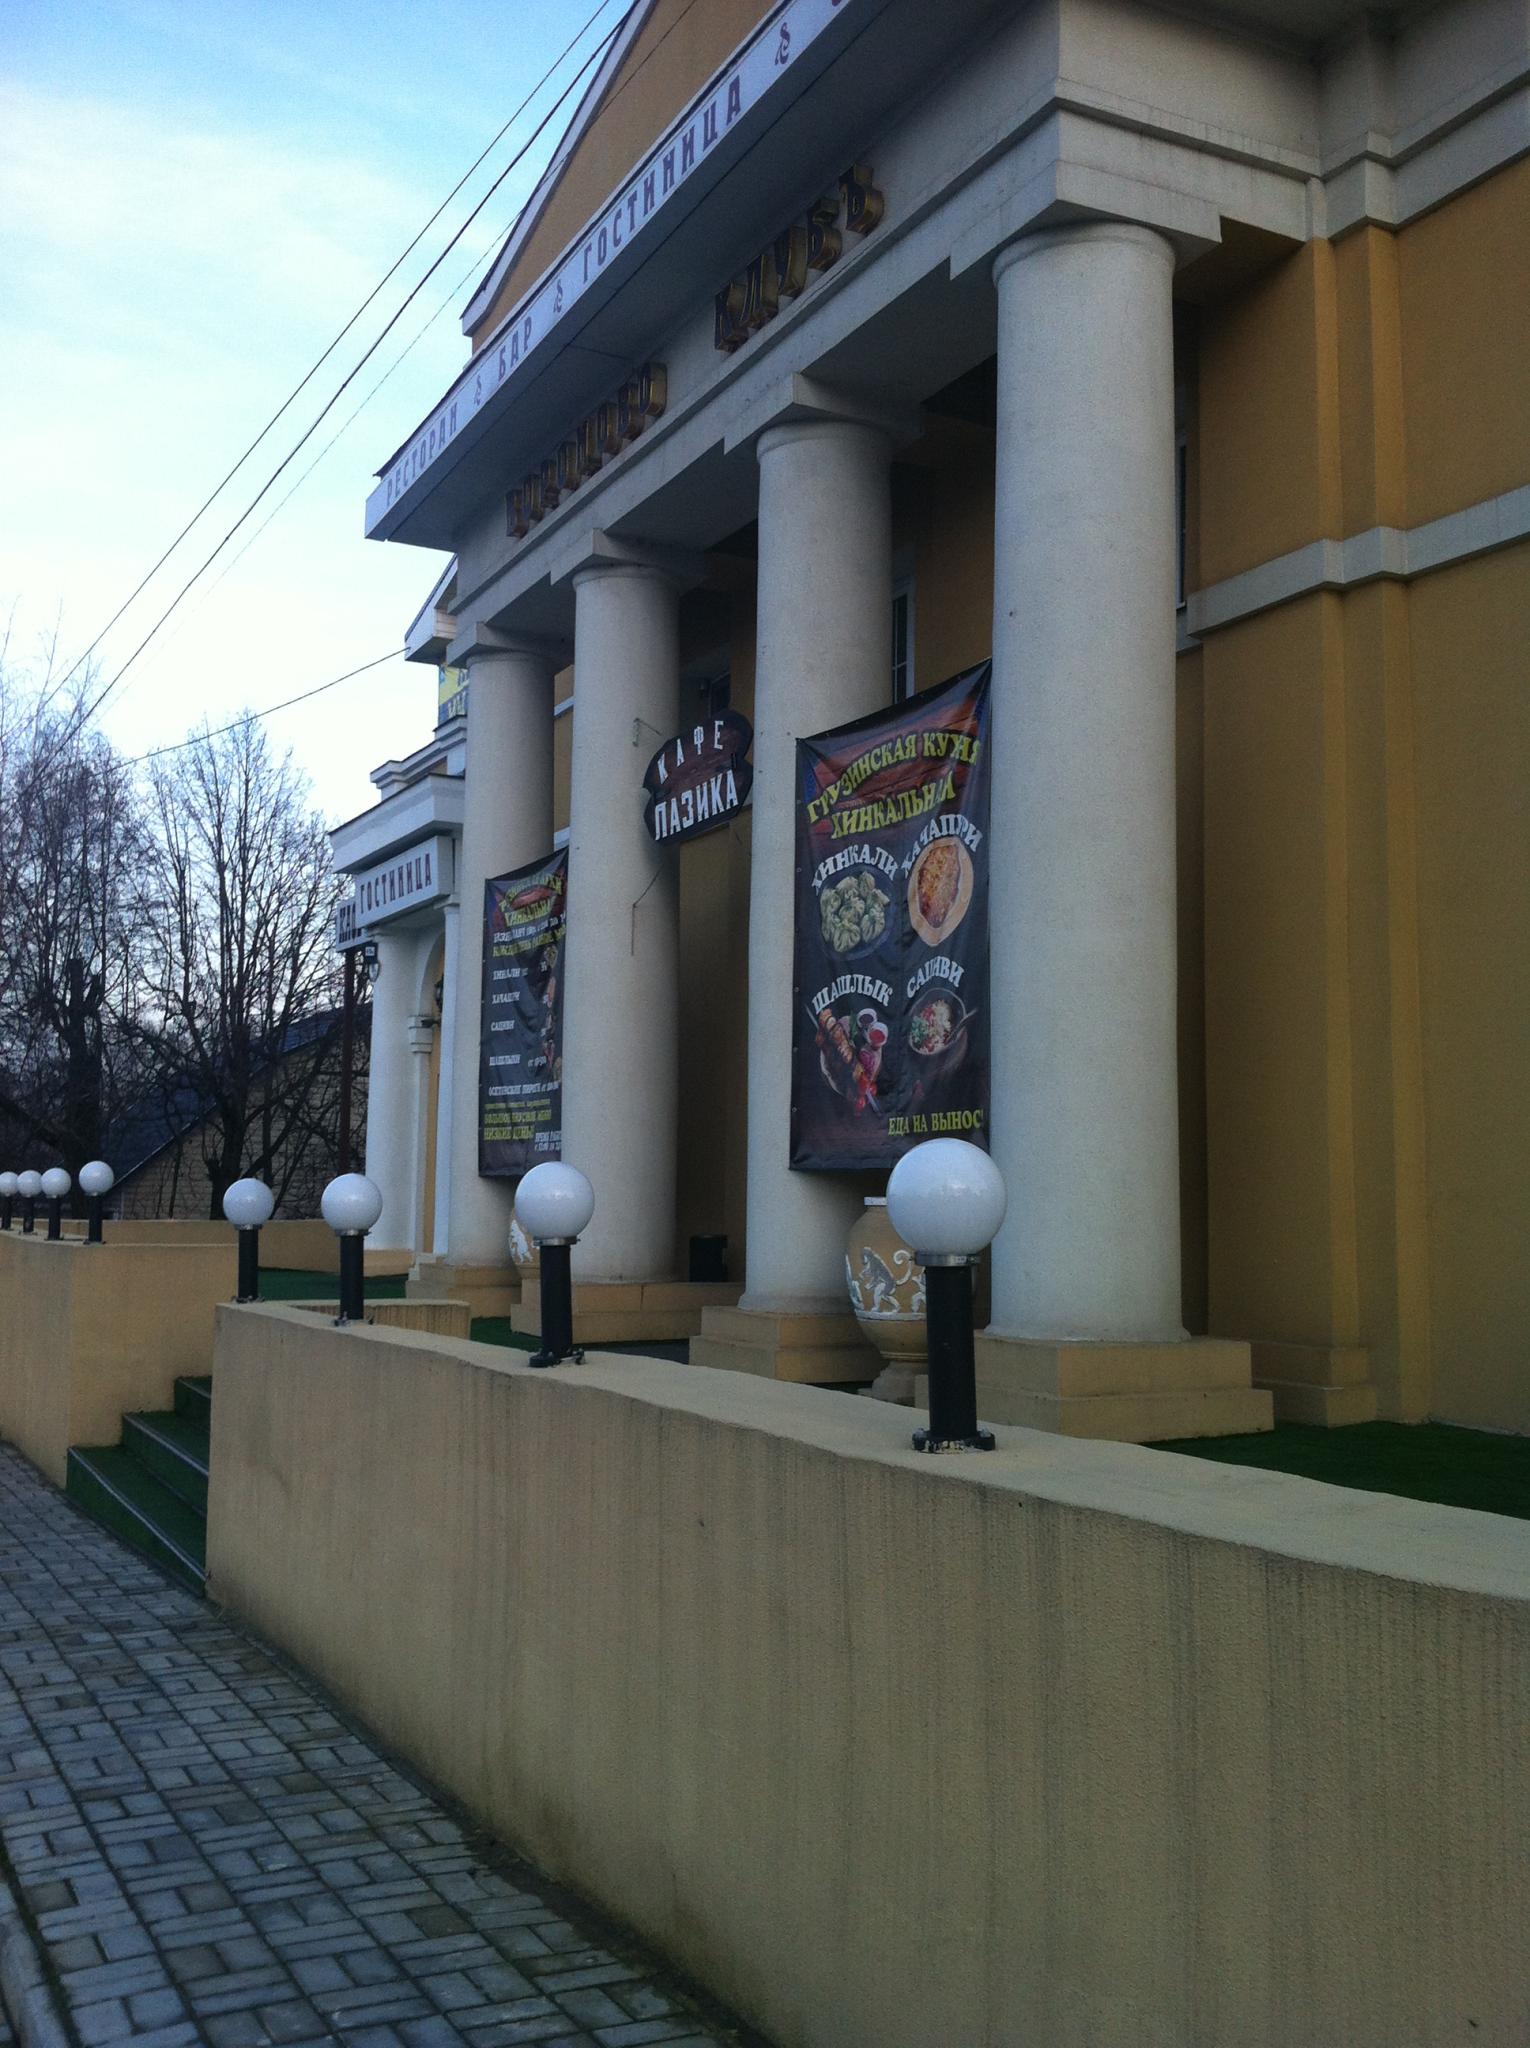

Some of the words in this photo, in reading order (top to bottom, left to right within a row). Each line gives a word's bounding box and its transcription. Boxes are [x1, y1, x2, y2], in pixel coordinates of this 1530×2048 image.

[386, 402, 458, 507] РЕСТОРАН
[498, 316, 533, 382] БАР
[583, 75, 742, 284] ГОСТИНИЦА
[656, 720, 725, 785] КАФЕ
[806, 734, 918, 824] ГРУЗИНСКАЯ
[811, 843, 899, 894] ХИНКАЛИ
[811, 973, 894, 1015] ШАШЛЫК
[912, 1114, 929, 1133] НА
